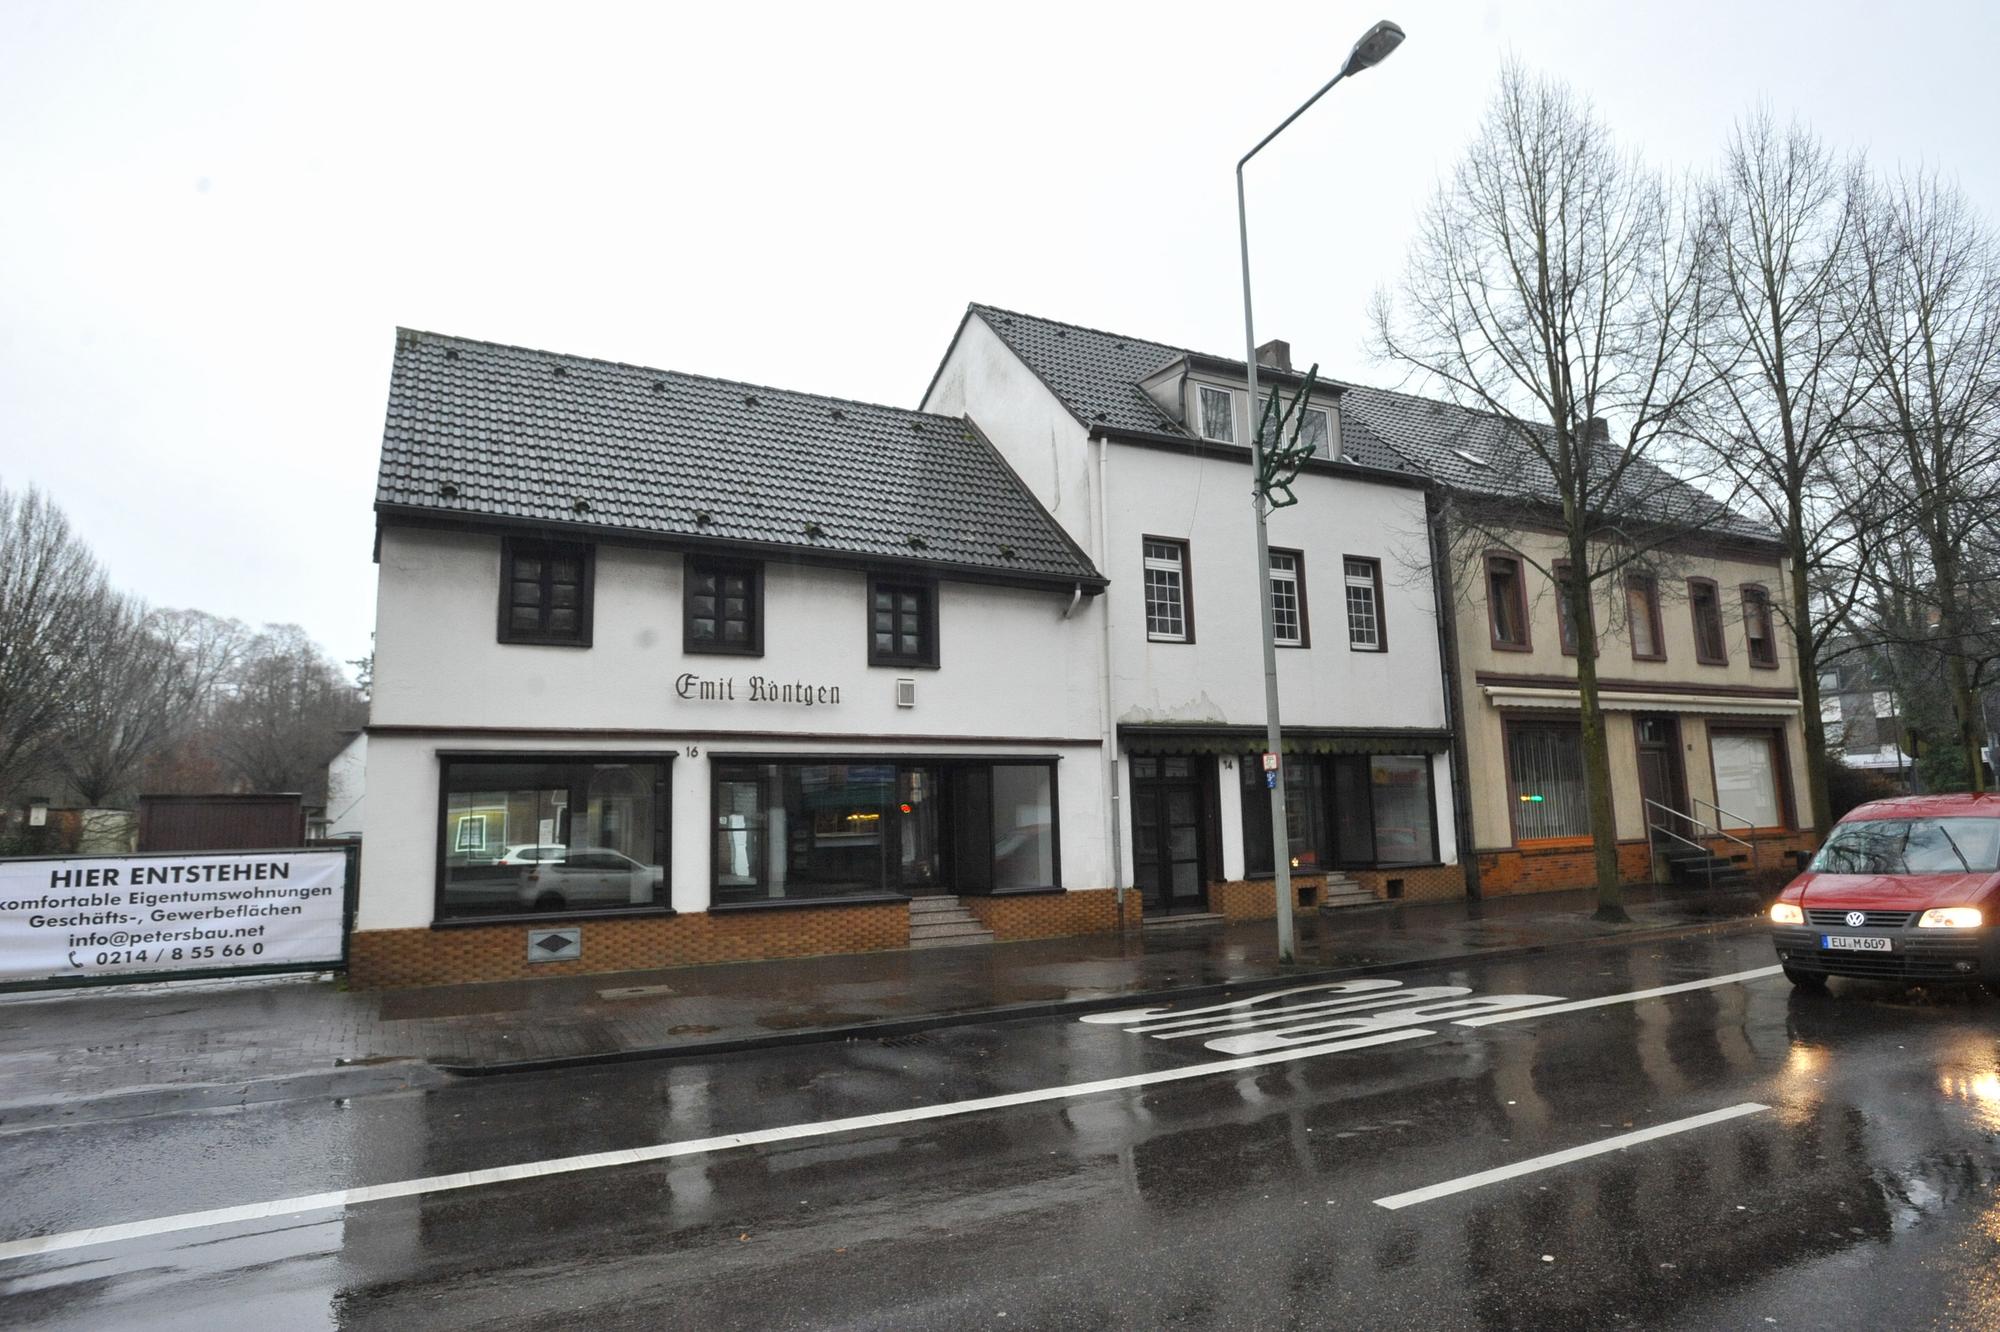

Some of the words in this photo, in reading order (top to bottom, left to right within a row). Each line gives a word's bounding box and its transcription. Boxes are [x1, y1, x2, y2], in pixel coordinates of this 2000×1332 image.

[675, 673, 735, 700] Emil
[748, 675, 840, 706] Röntgen
[685, 746, 699, 758] 16
[1223, 759, 1233, 770] 14
[50, 868, 119, 888] HIER
[130, 862, 290, 885] ENTSTEHEN
[129, 885, 332, 905] Eigentumswohnungen
[29, 910, 143, 928] Geschäfts-,
[150, 904, 302, 923] Gewerbeflächen
[69, 925, 265, 947] info@petersbau.net
[1831, 937, 1847, 948] EU
[1863, 939, 1886, 949] 609
[96, 952, 148, 966] 0214
[155, 949, 164, 962] /
[171, 948, 183, 961] 8
[191, 946, 214, 959] 55
[222, 944, 245, 957] 66
[253, 942, 264, 955] 0
[1079, 978, 1569, 1054] BUS
